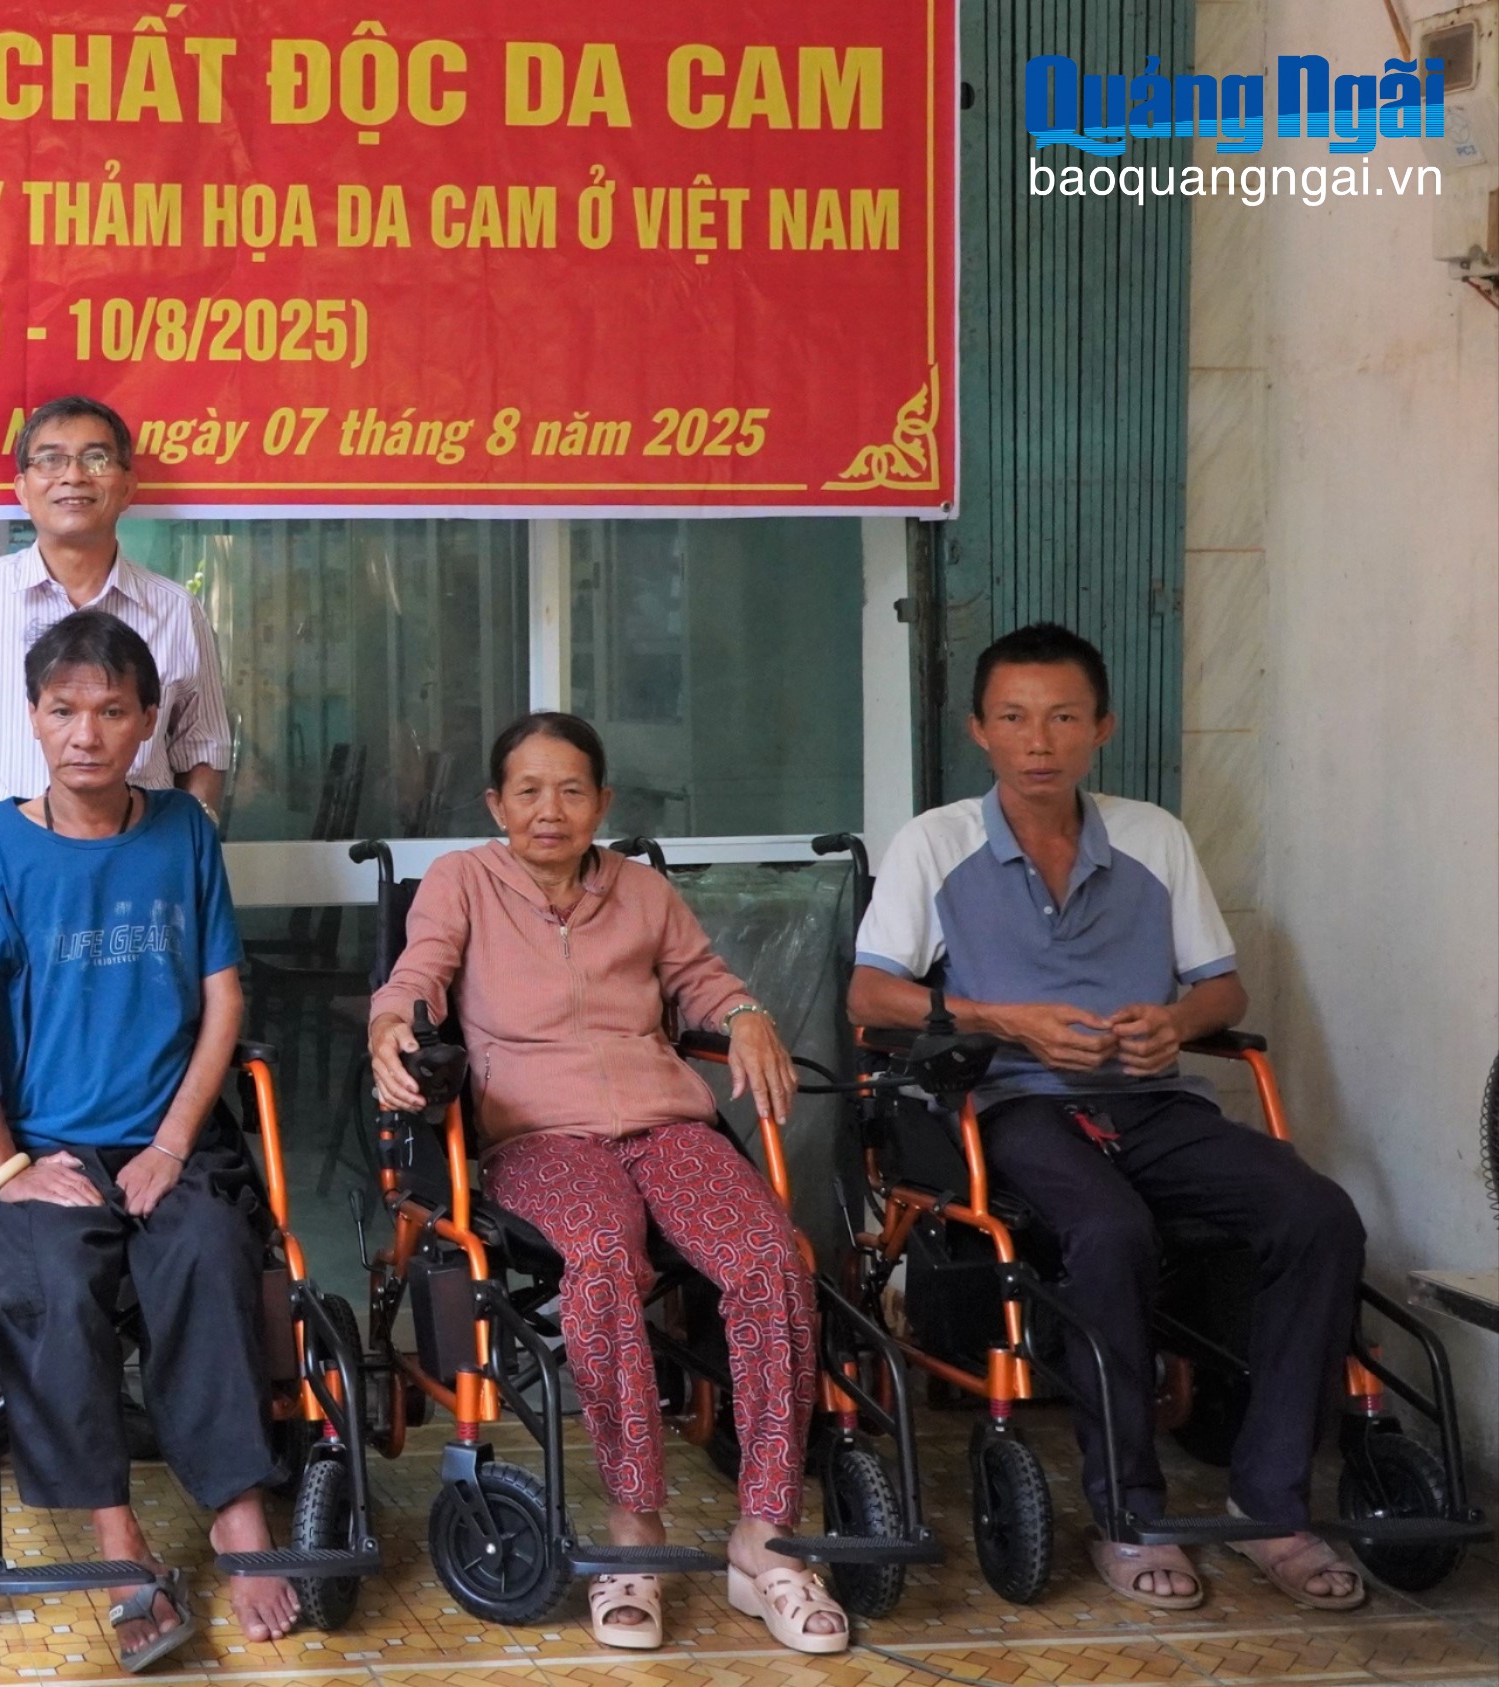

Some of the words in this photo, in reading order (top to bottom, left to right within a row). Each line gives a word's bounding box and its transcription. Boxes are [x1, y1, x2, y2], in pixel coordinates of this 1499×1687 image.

[267, 21, 466, 144] ĐỘC
[506, 42, 631, 127] DA
[668, 45, 882, 128] CAM
[22, 159, 182, 246] THẢM
[204, 183, 317, 262] HỌA
[338, 185, 410, 248] DA
[431, 185, 556, 249] CAM
[579, 165, 616, 250] Ở
[634, 175, 749, 264] VIỆT
[770, 188, 899, 250] NAM
[28, 327, 47, 340] -
[70, 298, 368, 368] 10/8/2025)
[136, 407, 249, 465] ngày
[263, 406, 328, 456] 07
[339, 407, 475, 465] tháng
[485, 407, 521, 456] 8
[531, 407, 632, 456] năm
[644, 407, 770, 456] 2025
[55, 929, 104, 964] LIFE
